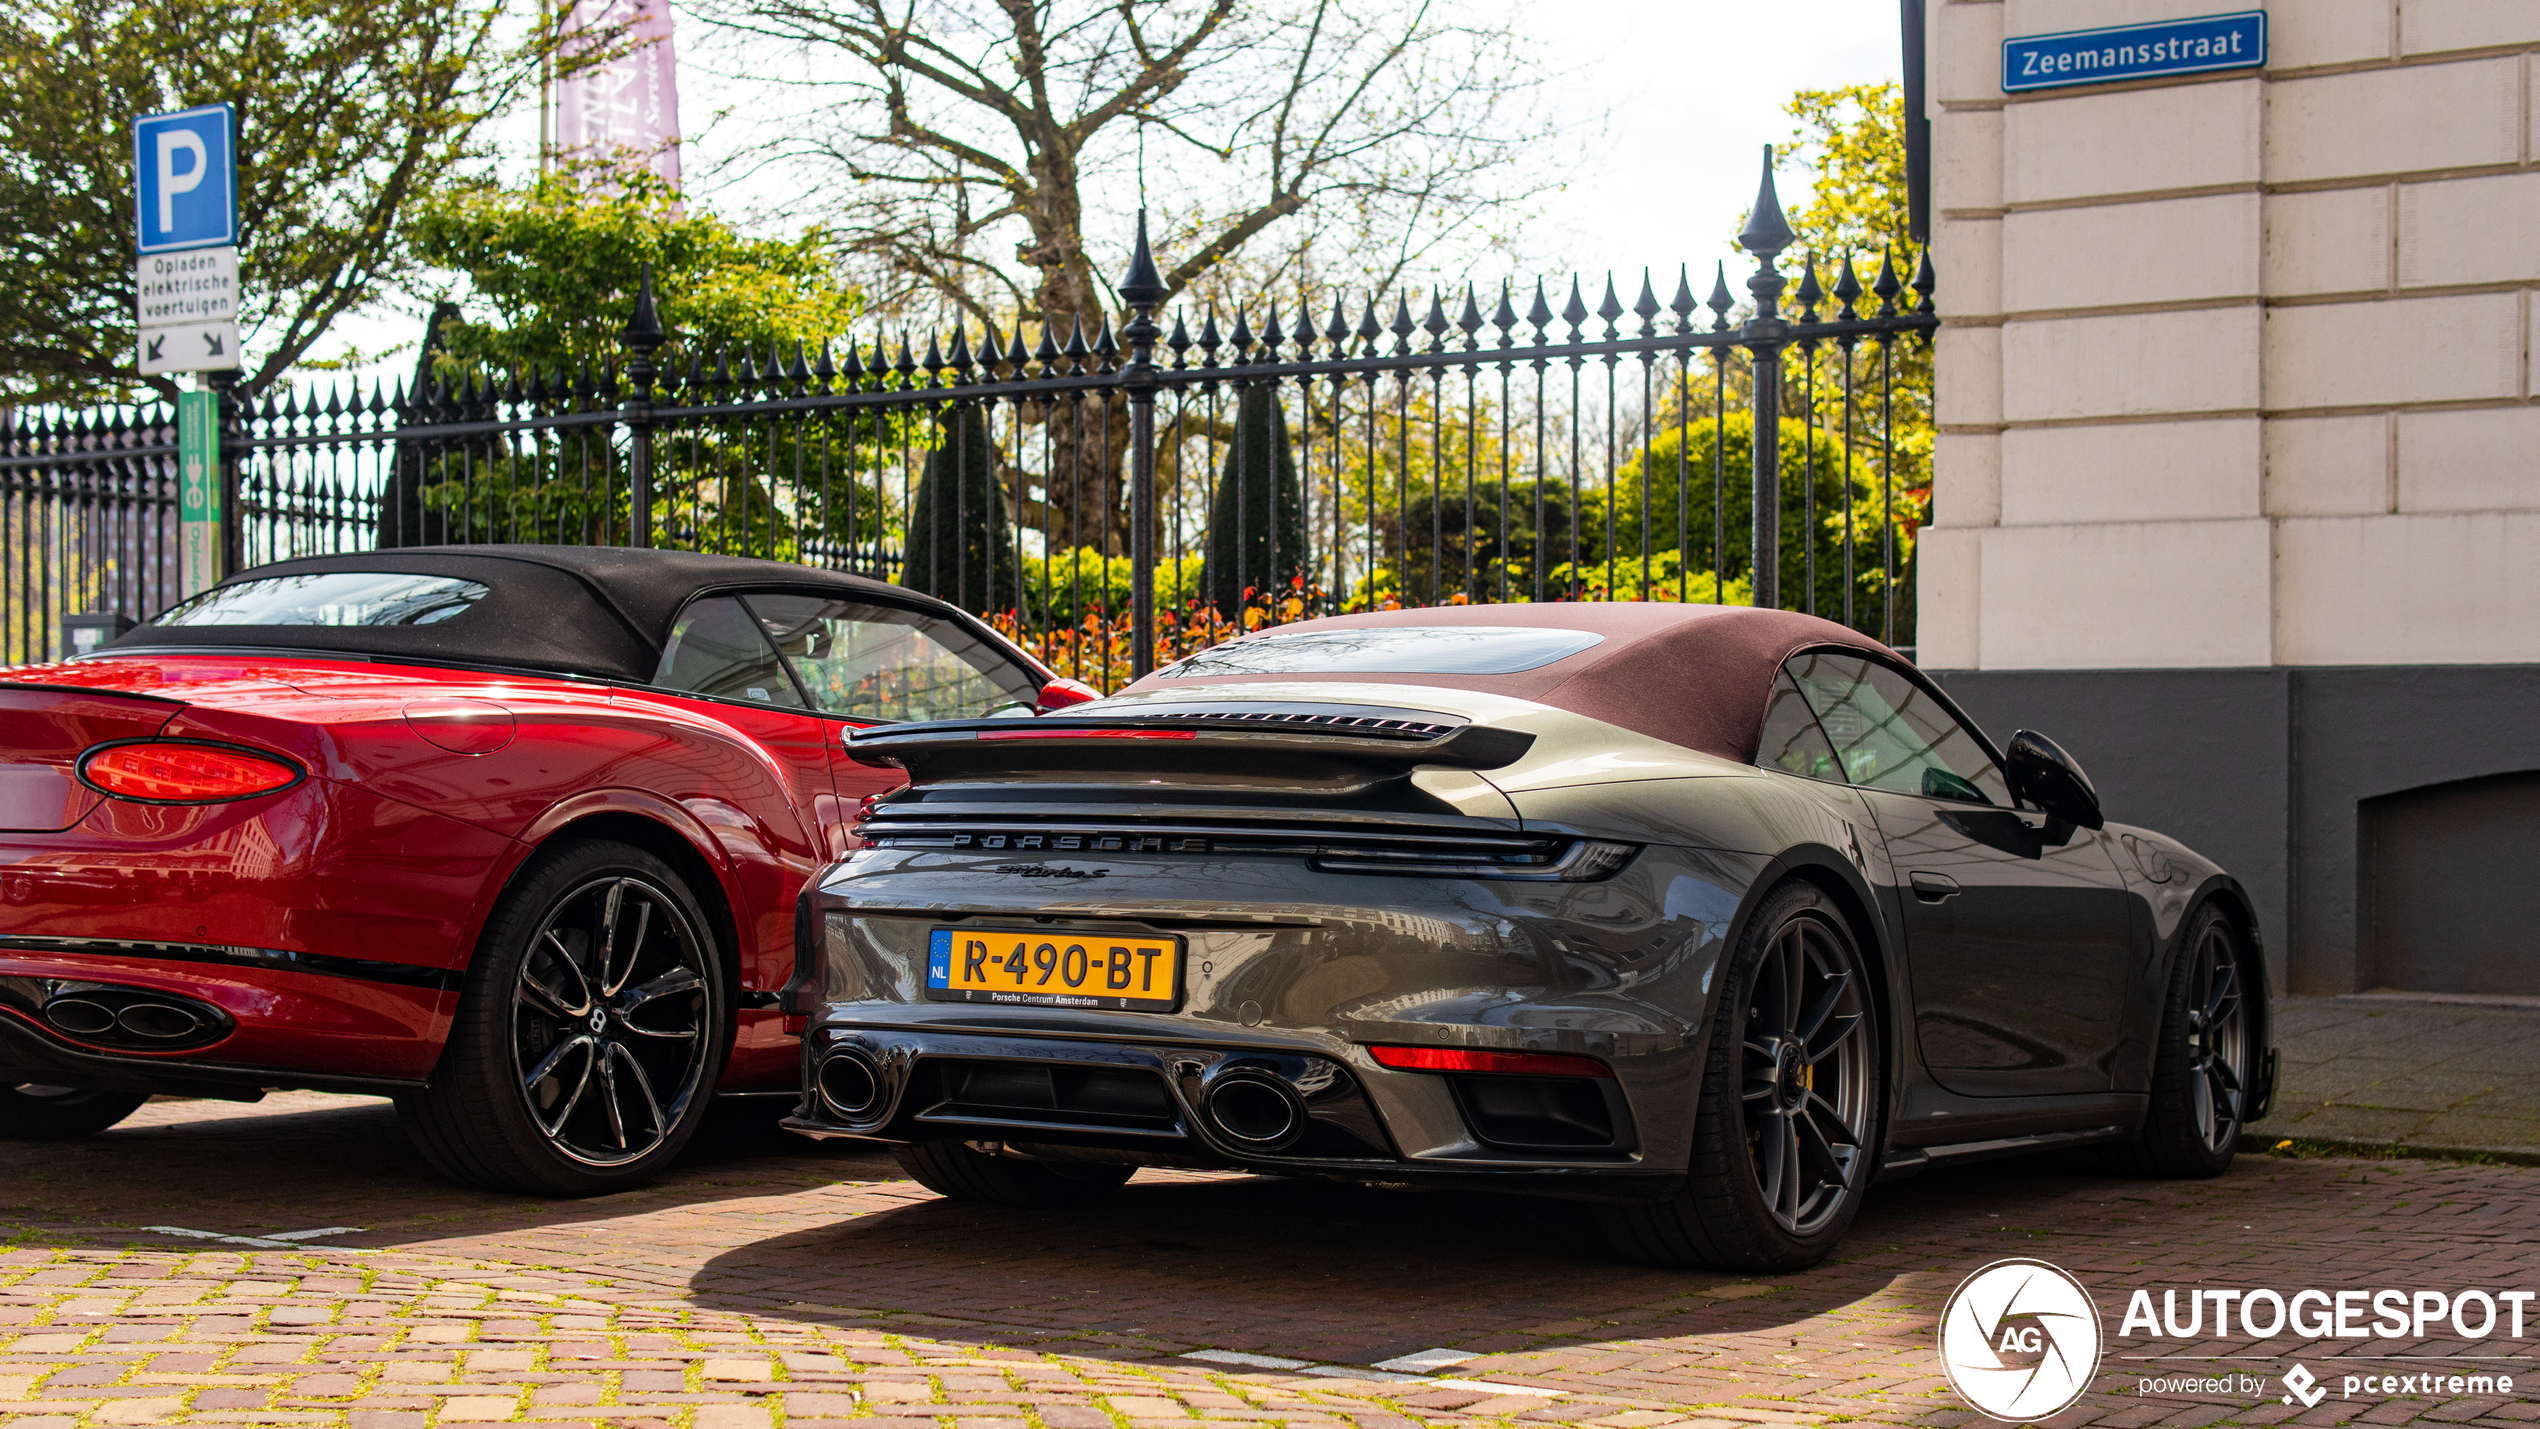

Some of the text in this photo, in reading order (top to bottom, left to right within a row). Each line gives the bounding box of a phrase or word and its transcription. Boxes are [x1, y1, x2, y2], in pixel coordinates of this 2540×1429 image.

[2022, 29, 2243, 77] Zeemansstraat
[157, 128, 208, 234] P
[154, 255, 217, 277] Opladen
[142, 273, 230, 297] elektrische
[145, 296, 229, 318] voertuigen
[953, 834, 1210, 852] PORSCHE
[931, 966, 947, 980] NL
[963, 940, 1162, 992] R-490-BT
[992, 992, 1098, 1006] Porsche Centrum Amsterdam
